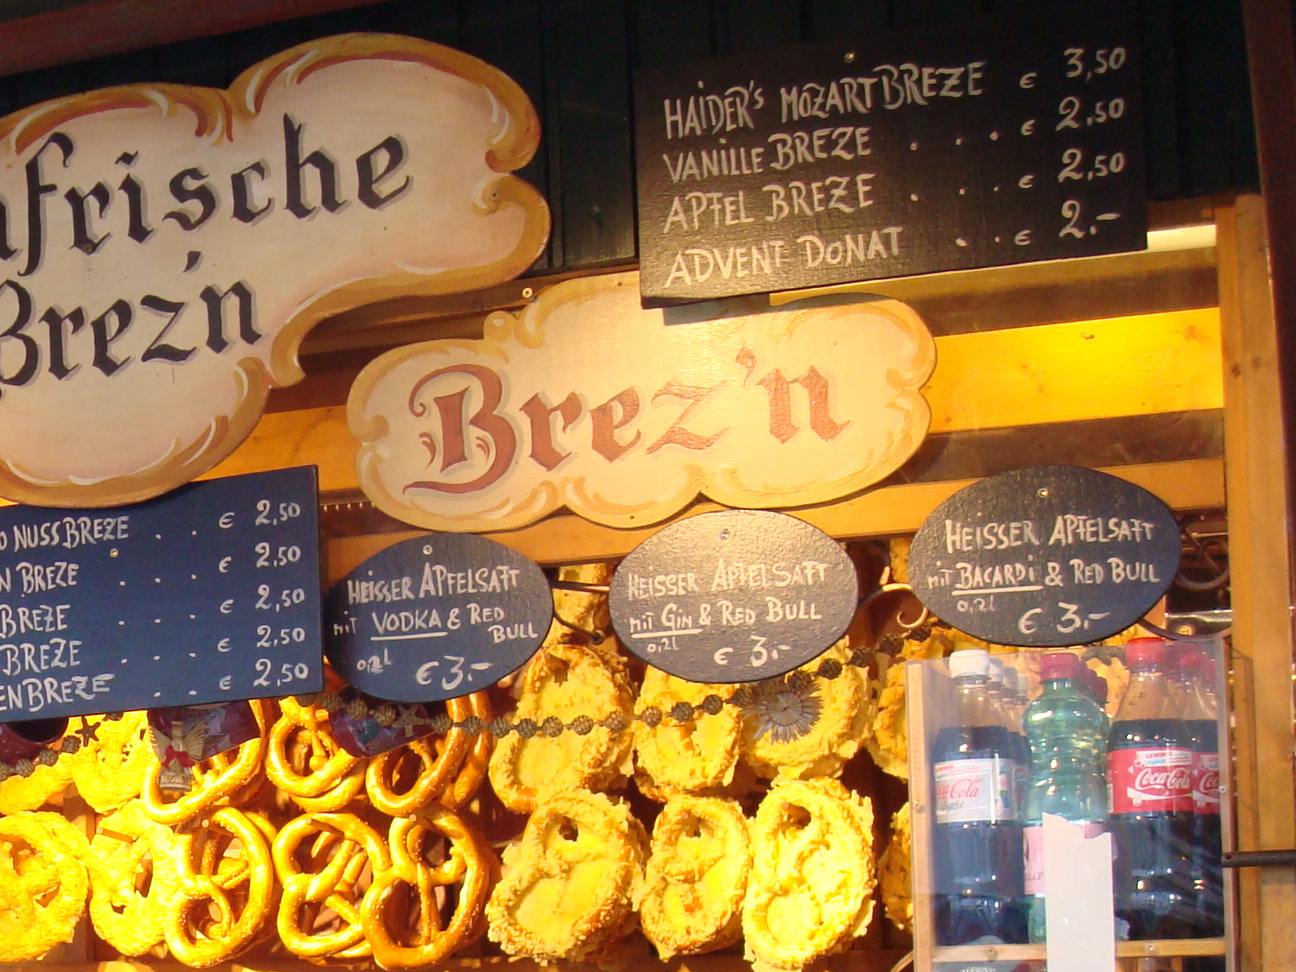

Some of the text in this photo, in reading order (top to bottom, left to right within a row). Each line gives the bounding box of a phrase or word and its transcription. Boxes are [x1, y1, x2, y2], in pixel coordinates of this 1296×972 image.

[1019, 72, 1037, 90] €
[1063, 47, 1127, 83] 3,50
[1021, 118, 1035, 136] €
[1055, 96, 1126, 133] 2,50
[763, 174, 877, 222] BREZE
[1019, 172, 1035, 191] €
[1058, 148, 1126, 184] 2,50
[664, 239, 787, 290] ADVENT
[796, 226, 904, 270] DONAT
[1015, 228, 1031, 247] €
[403, 345, 853, 496] Brez'n
[218, 510, 235, 530] €
[255, 499, 302, 528] 2,50
[945, 513, 1155, 553] HEISSER APFELSAFT
[20, 562, 79, 597] BREZE
[218, 555, 232, 574] €
[255, 542, 302, 570] 2,50
[419, 562, 520, 599] APFELSAFT
[1044, 562, 1064, 587] &
[1107, 557, 1162, 583] BULL
[219, 597, 234, 614] €
[255, 584, 306, 612] 2,50
[699, 604, 711, 626] &
[766, 596, 822, 623] BULL
[371, 609, 442, 635] VODKA
[447, 608, 461, 630] &
[487, 623, 539, 644] BULL
[1018, 608, 1043, 634] €
[217, 636, 232, 653] €
[256, 625, 306, 650] 2,50
[714, 647, 733, 665] €
[218, 674, 232, 691] €
[253, 658, 309, 688] 2,50
[416, 661, 439, 685] €
